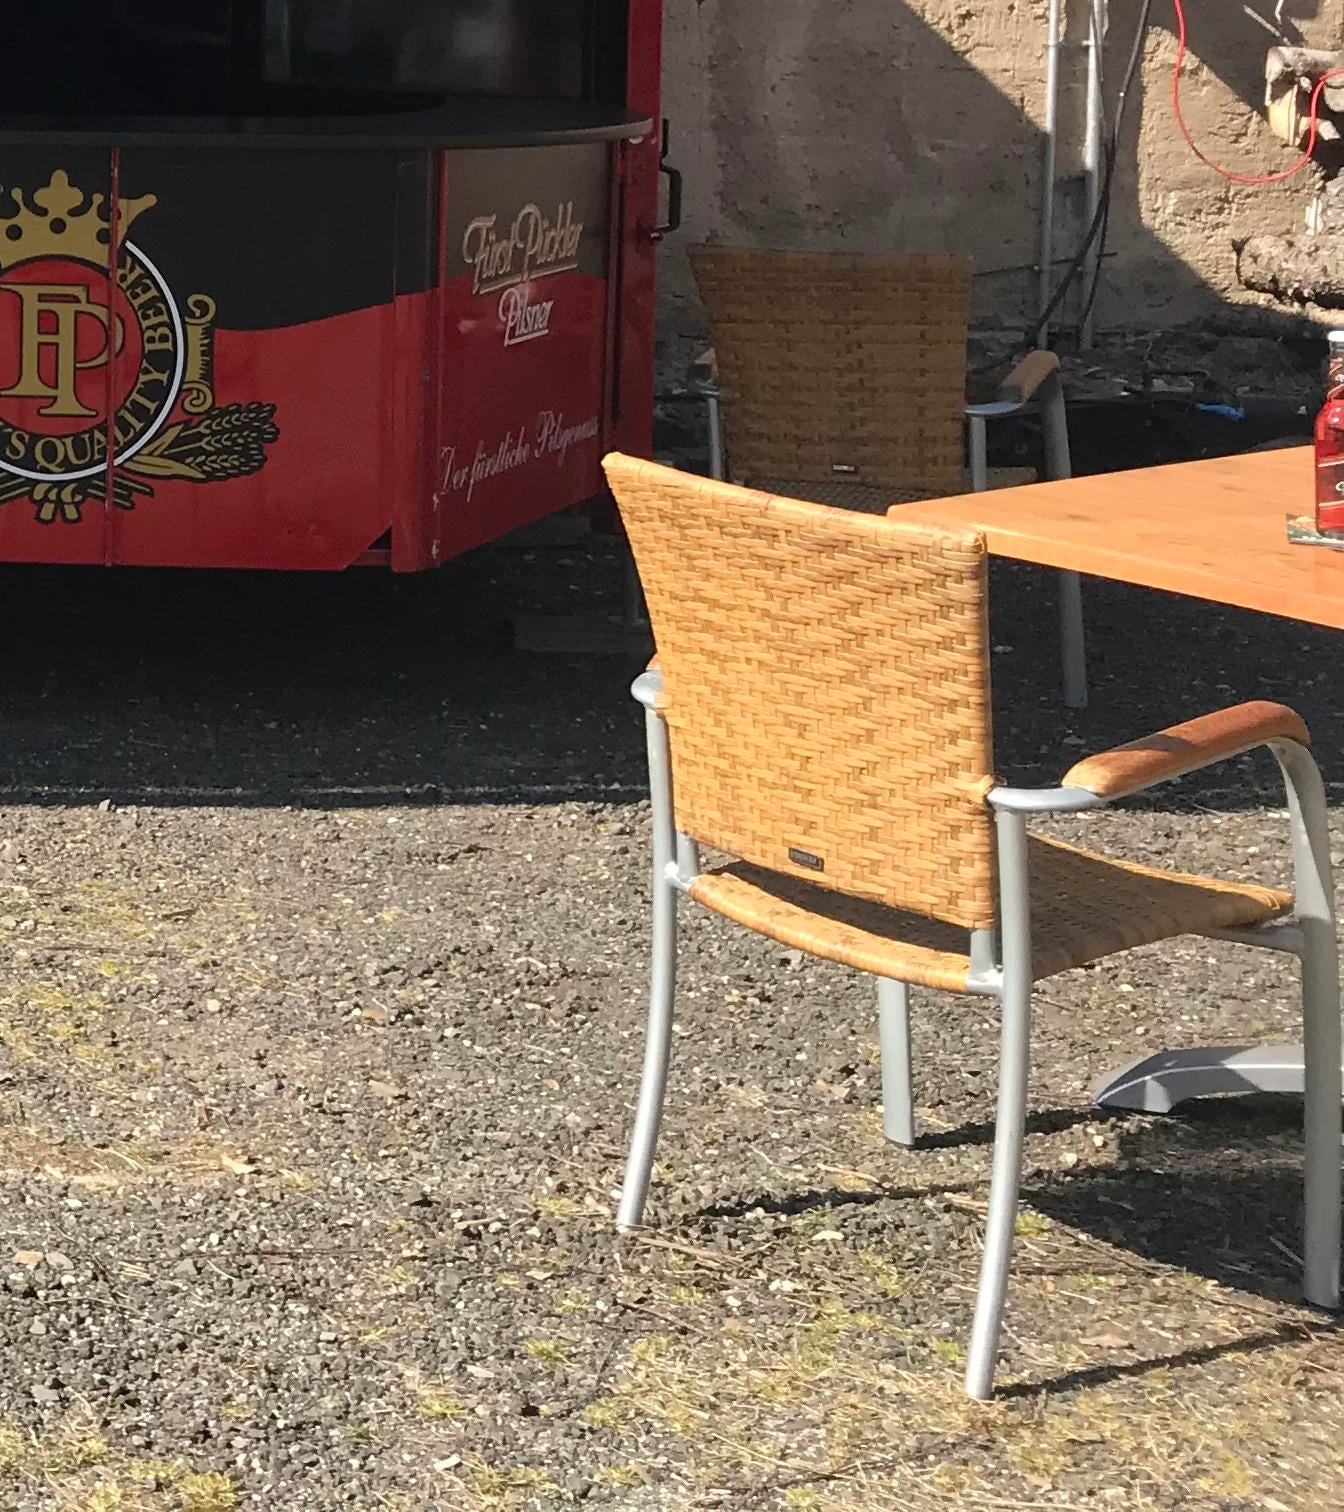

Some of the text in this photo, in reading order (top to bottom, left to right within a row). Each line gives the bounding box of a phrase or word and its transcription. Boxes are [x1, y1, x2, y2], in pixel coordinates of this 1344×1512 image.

[462, 201, 584, 295] Fürst Pückler
[498, 287, 554, 346] Pilsner
[33, 362, 170, 473] QUALITY
[116, 255, 174, 353] BEER
